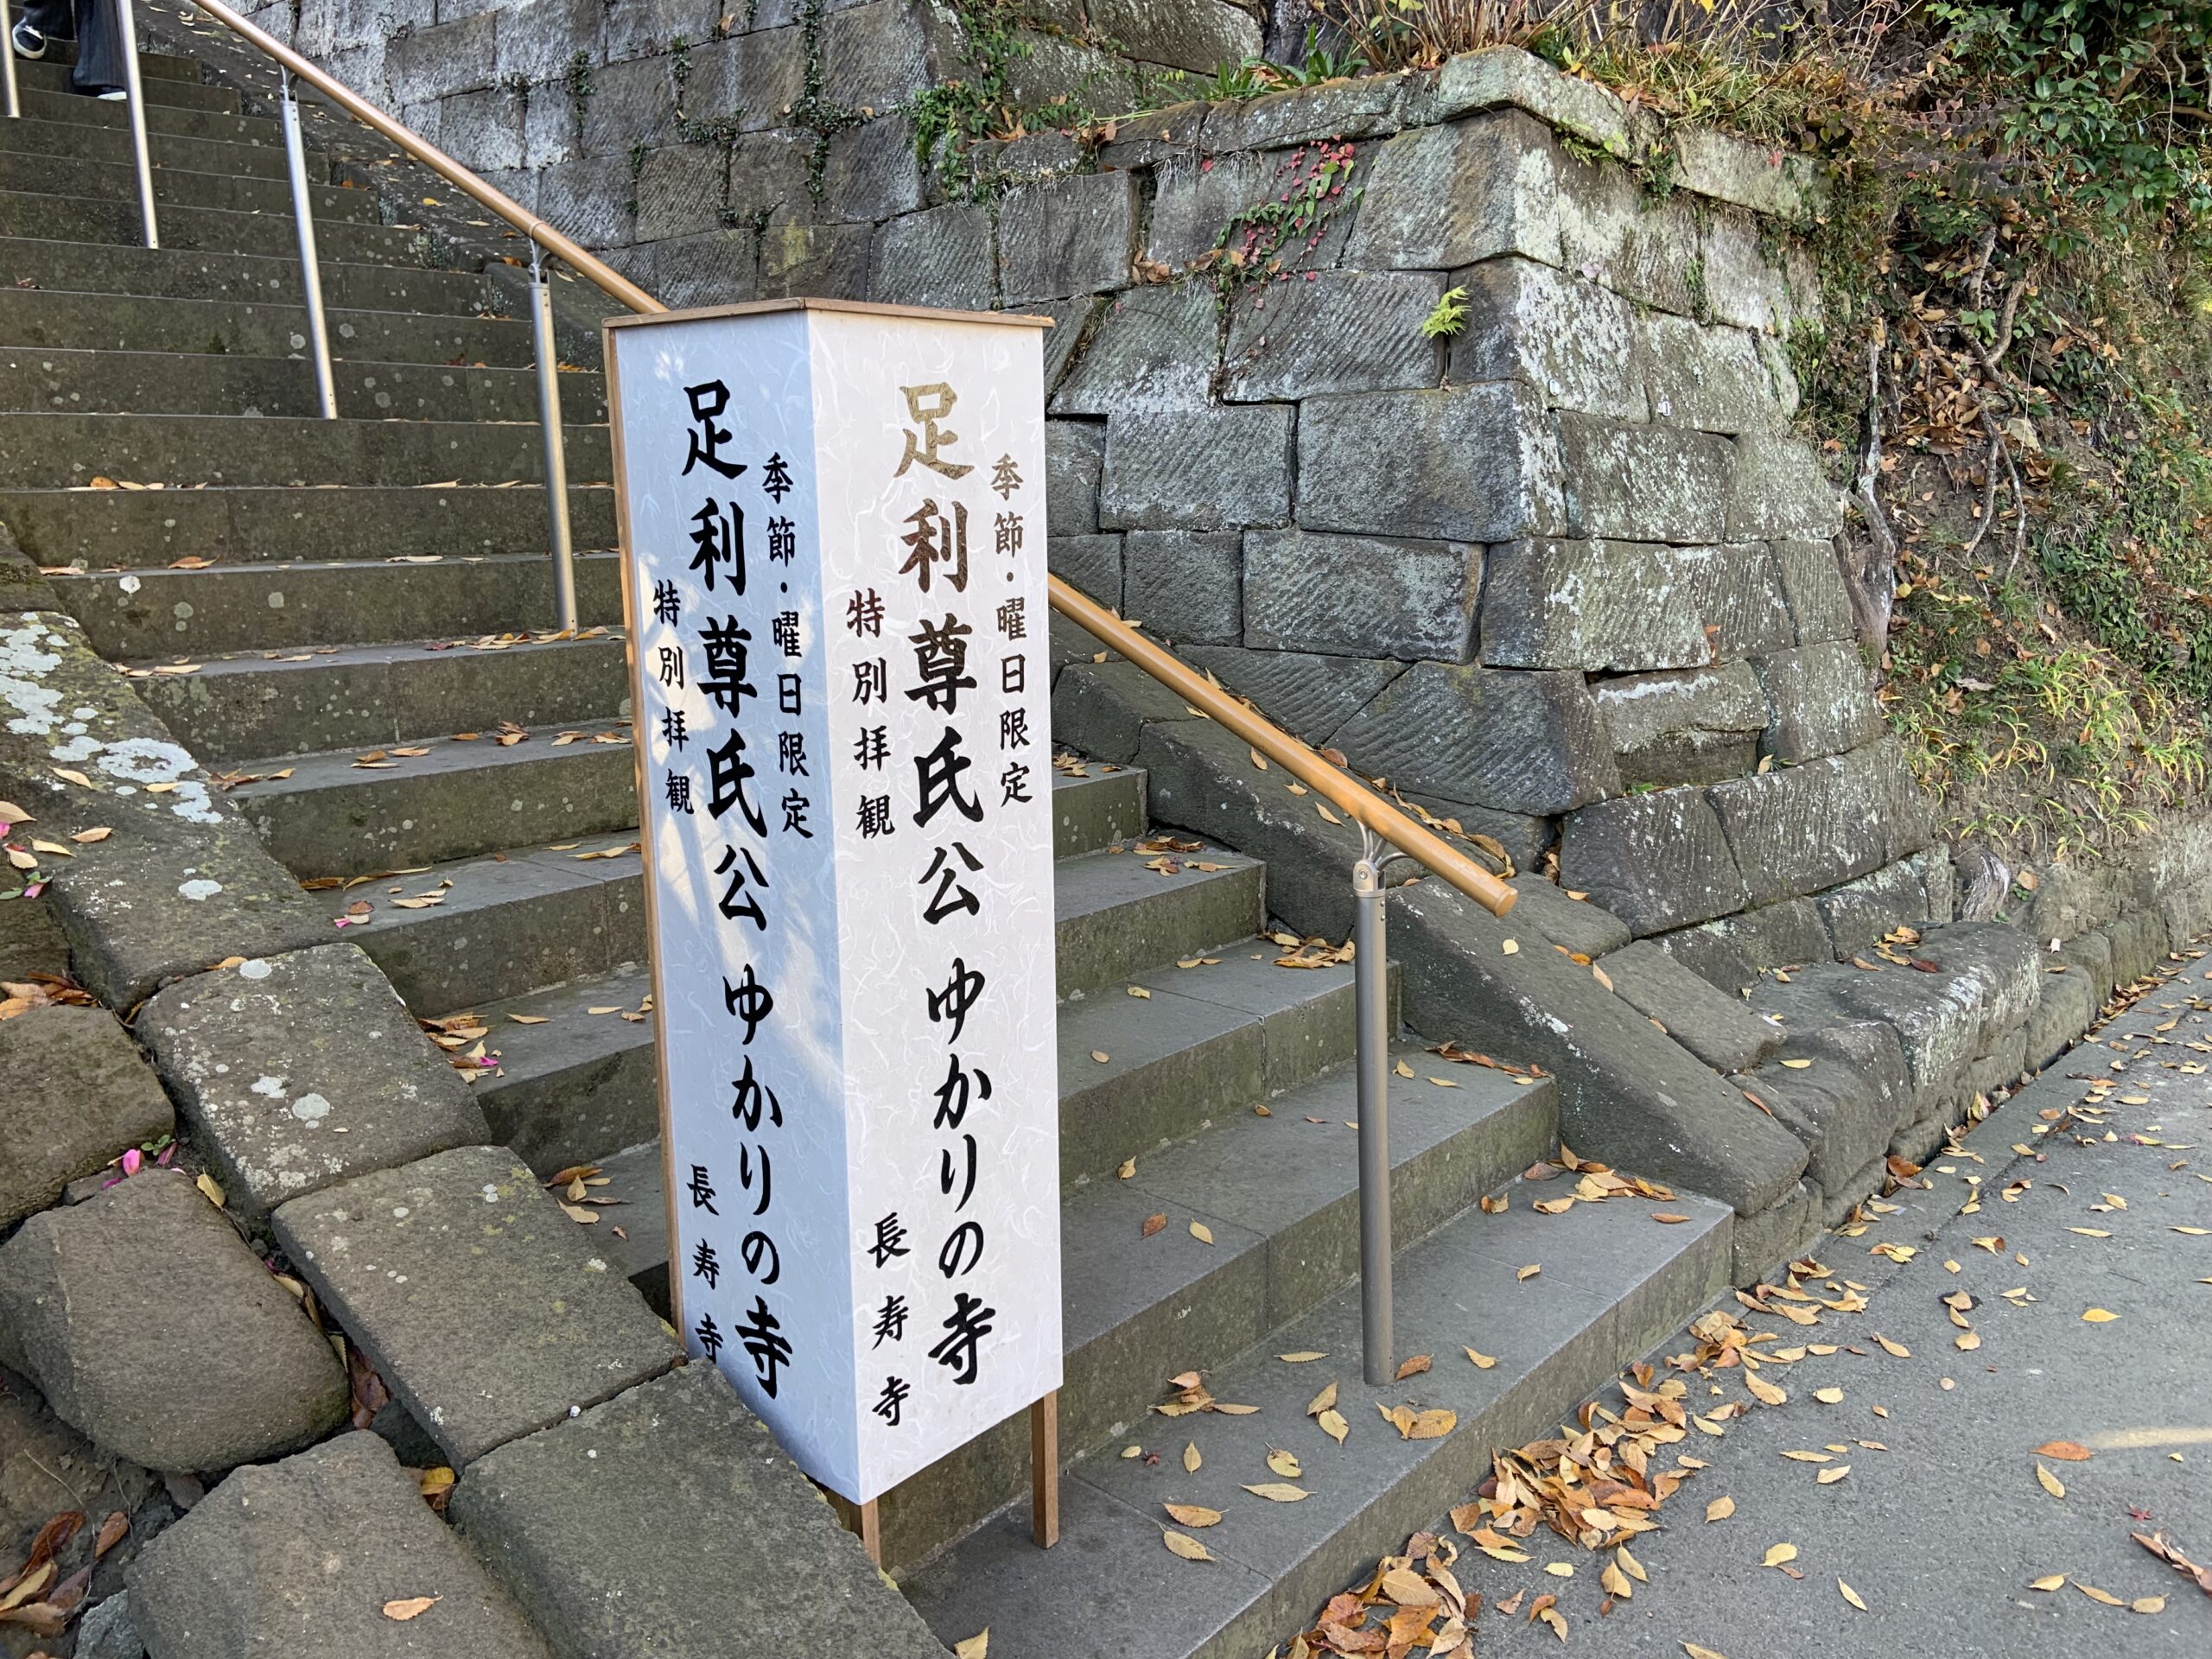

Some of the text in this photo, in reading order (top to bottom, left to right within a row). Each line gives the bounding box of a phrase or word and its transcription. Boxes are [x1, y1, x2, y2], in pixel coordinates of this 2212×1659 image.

[652, 579, 695, 815] 特別拝観
[761, 452, 814, 839] 季節・曜日限定
[846, 588, 896, 840] 特別拝観
[990, 454, 1033, 808] 季節・曜日限定
[681, 378, 793, 1400] 足利尊氏公ゆかりの寺
[893, 381, 996, 1385] 足利尊氏公ゆかりの寺
[686, 1164, 724, 1363] 長寿寺
[867, 1212, 912, 1427] 長寿寺
